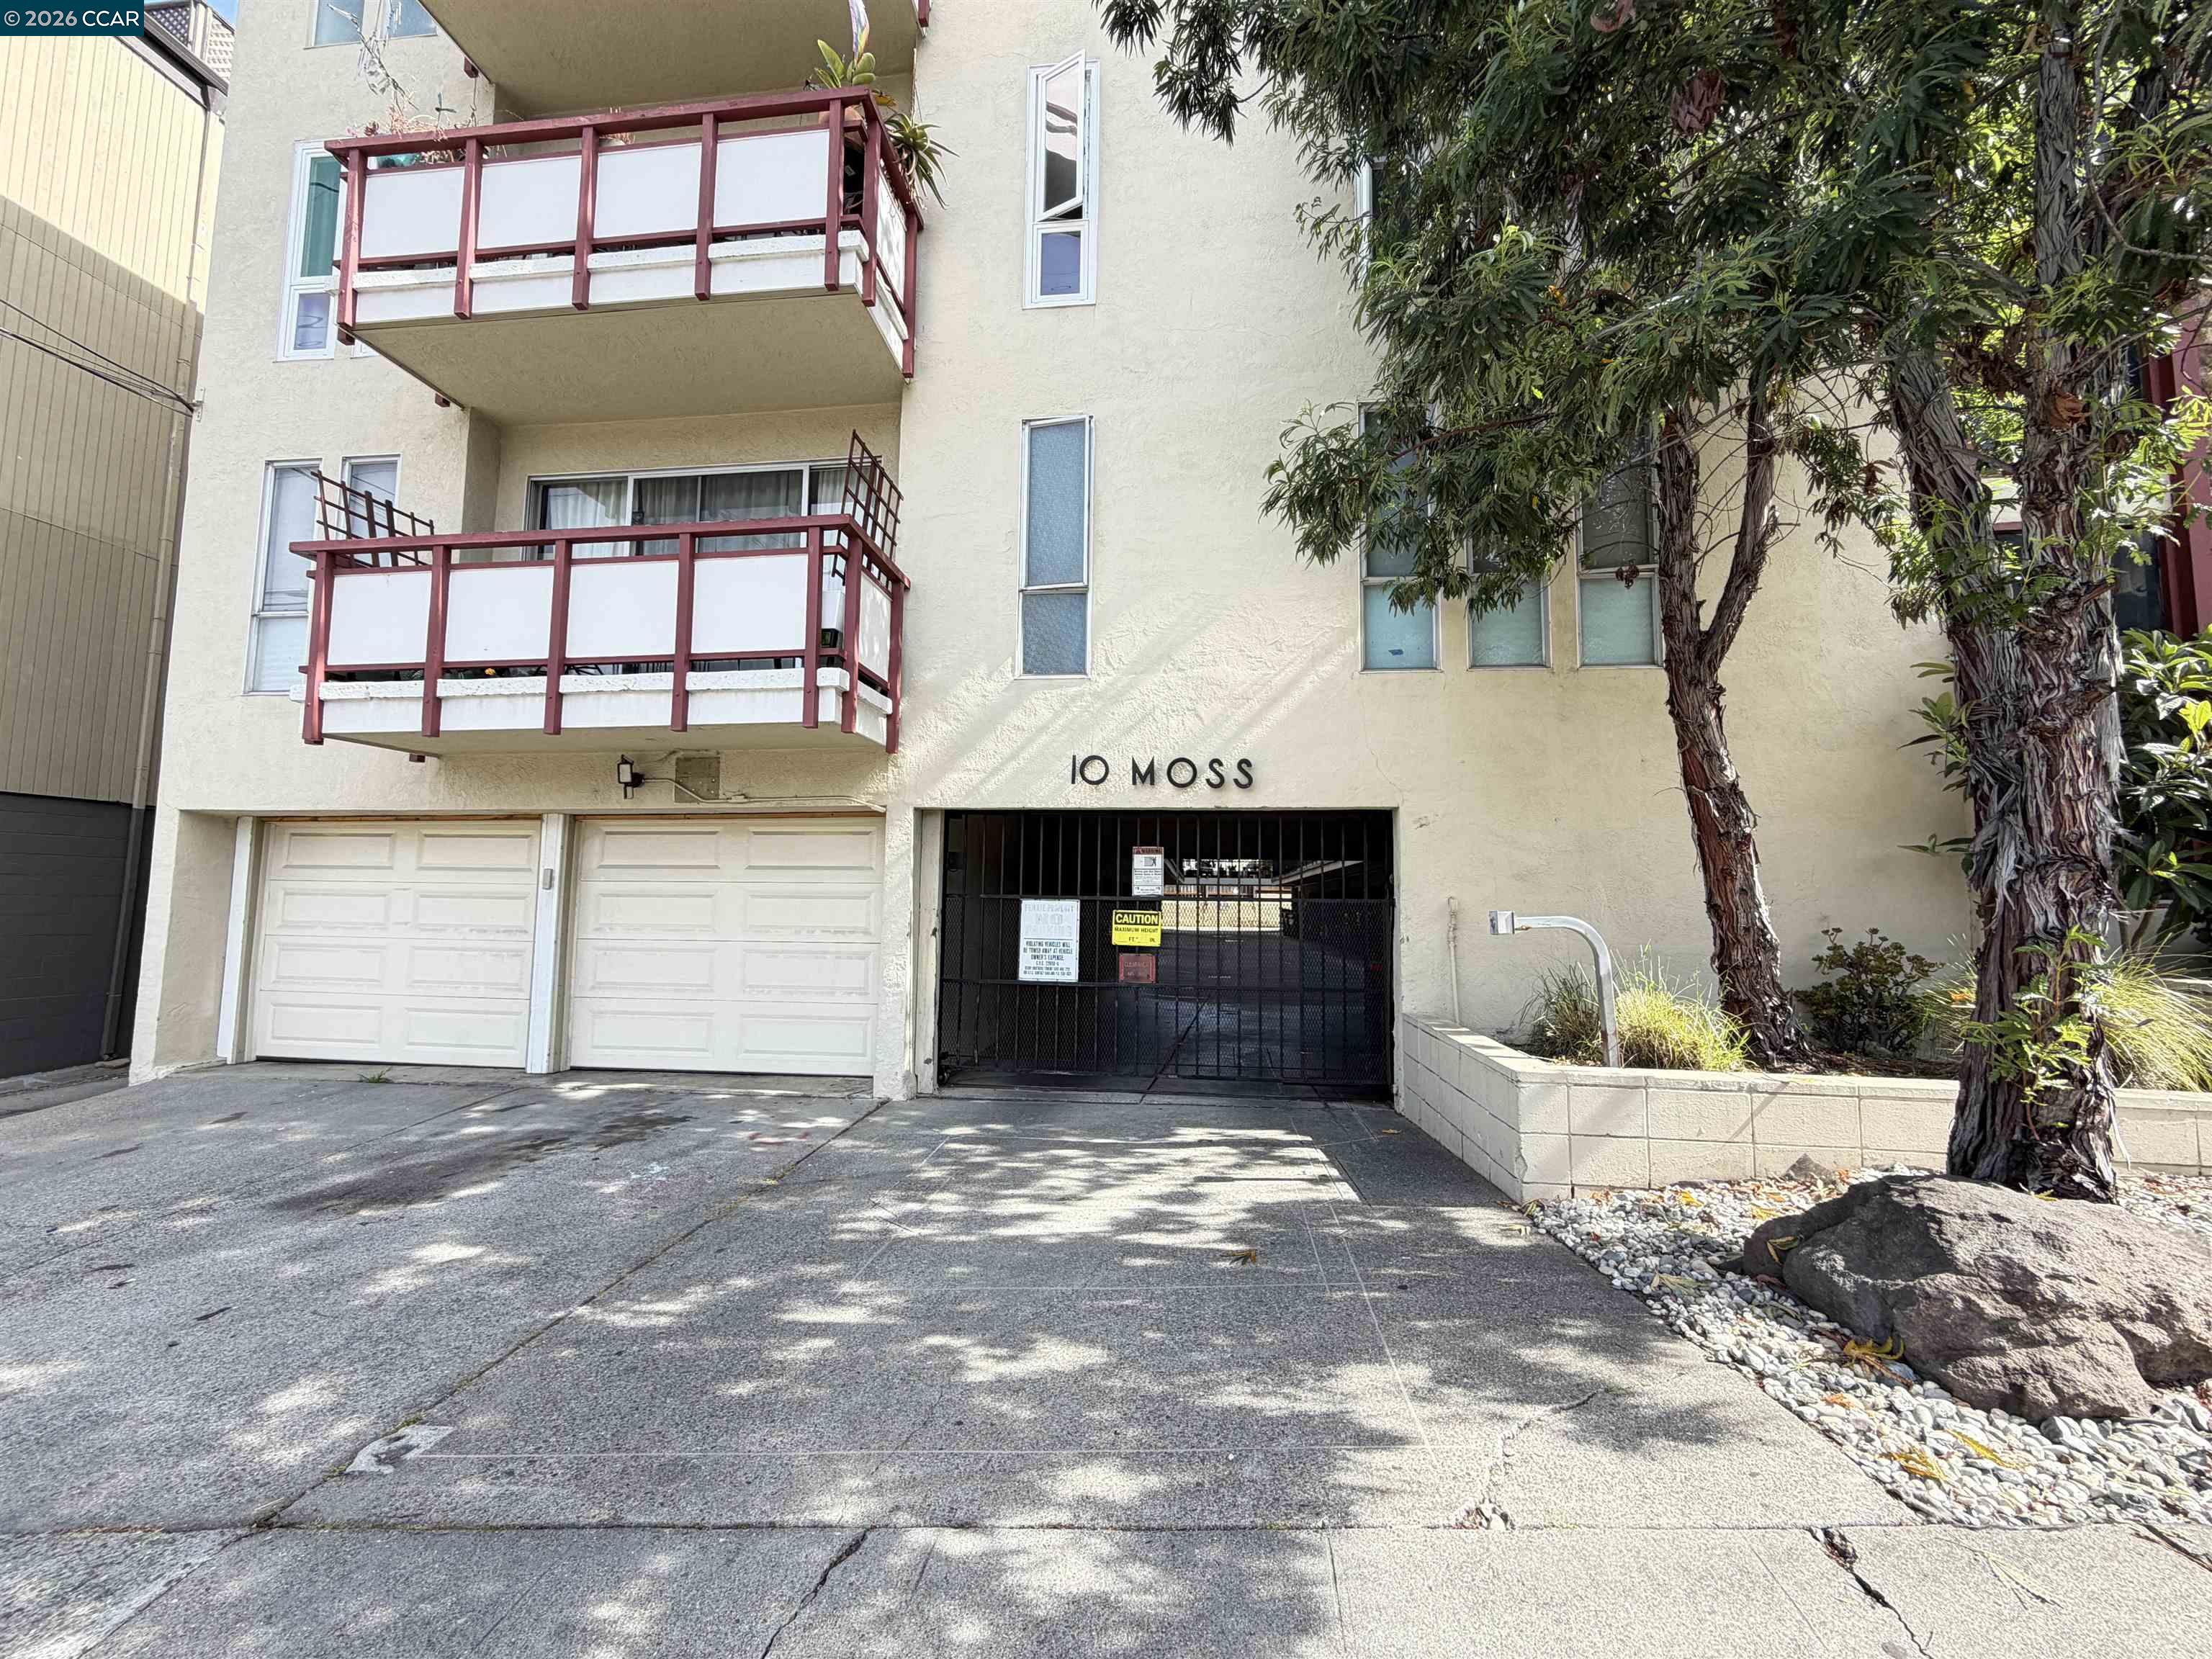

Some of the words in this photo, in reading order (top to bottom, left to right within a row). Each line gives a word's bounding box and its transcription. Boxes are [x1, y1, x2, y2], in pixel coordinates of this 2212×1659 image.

[1071, 754, 1110, 786] 10
[1131, 755, 1254, 789] MOSS
[1115, 913, 1159, 925] CAUTION
